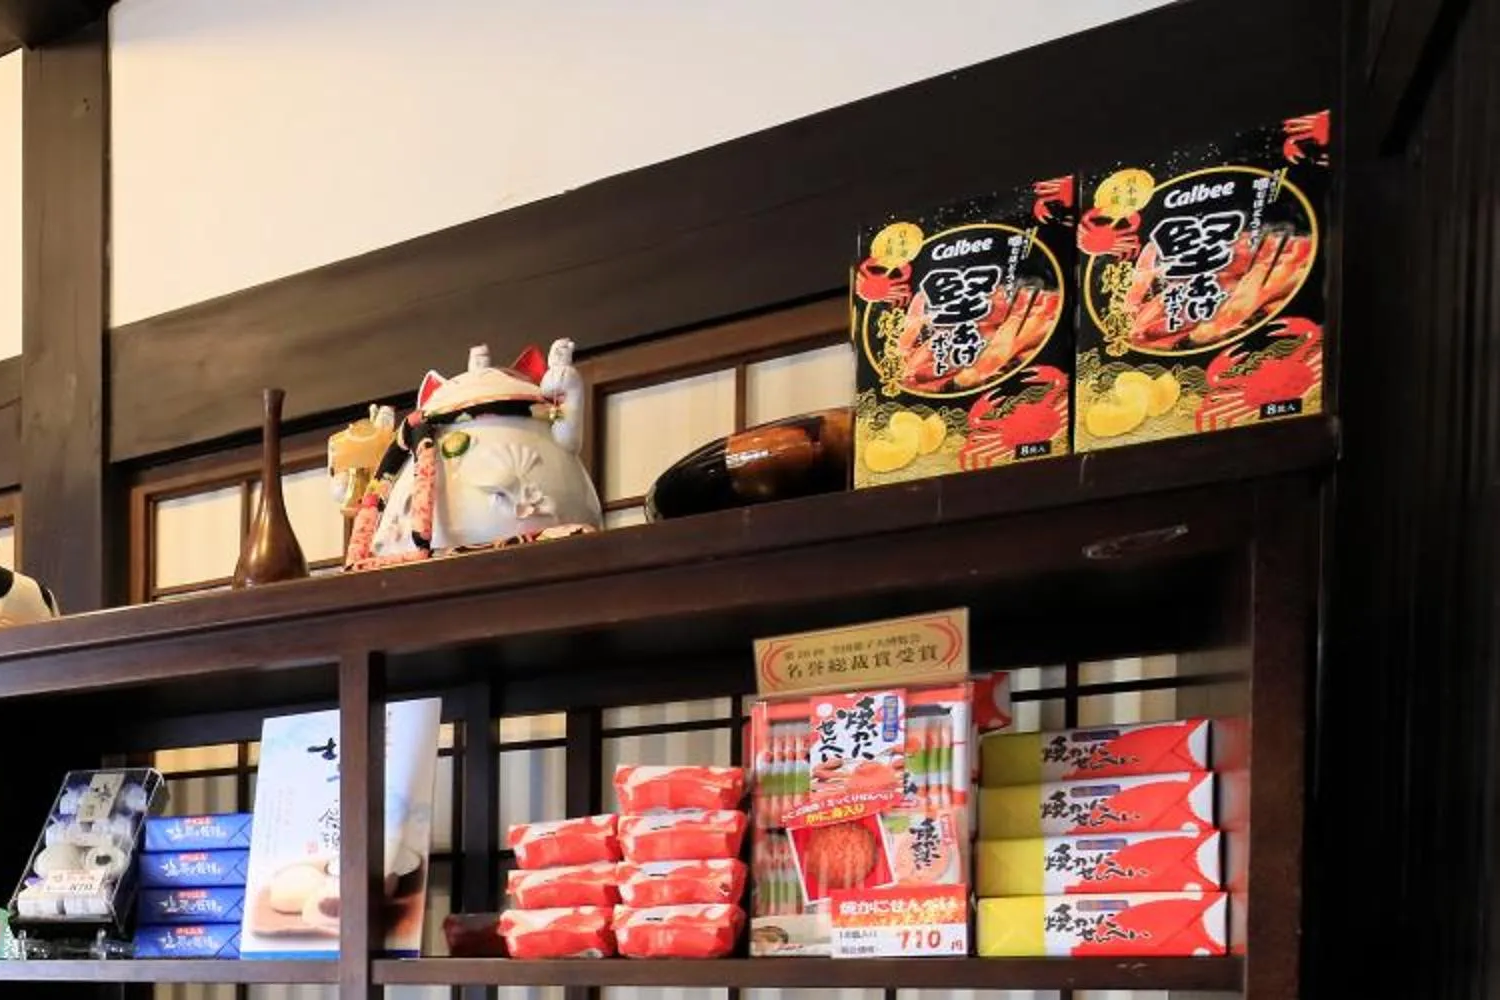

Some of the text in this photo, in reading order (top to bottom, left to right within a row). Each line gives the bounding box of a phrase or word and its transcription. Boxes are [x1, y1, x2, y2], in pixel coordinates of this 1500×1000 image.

[1164, 180, 1235, 208] Calbee
[931, 237, 994, 260] Calbee
[787, 644, 939, 680] 名誉総裁賞受賞
